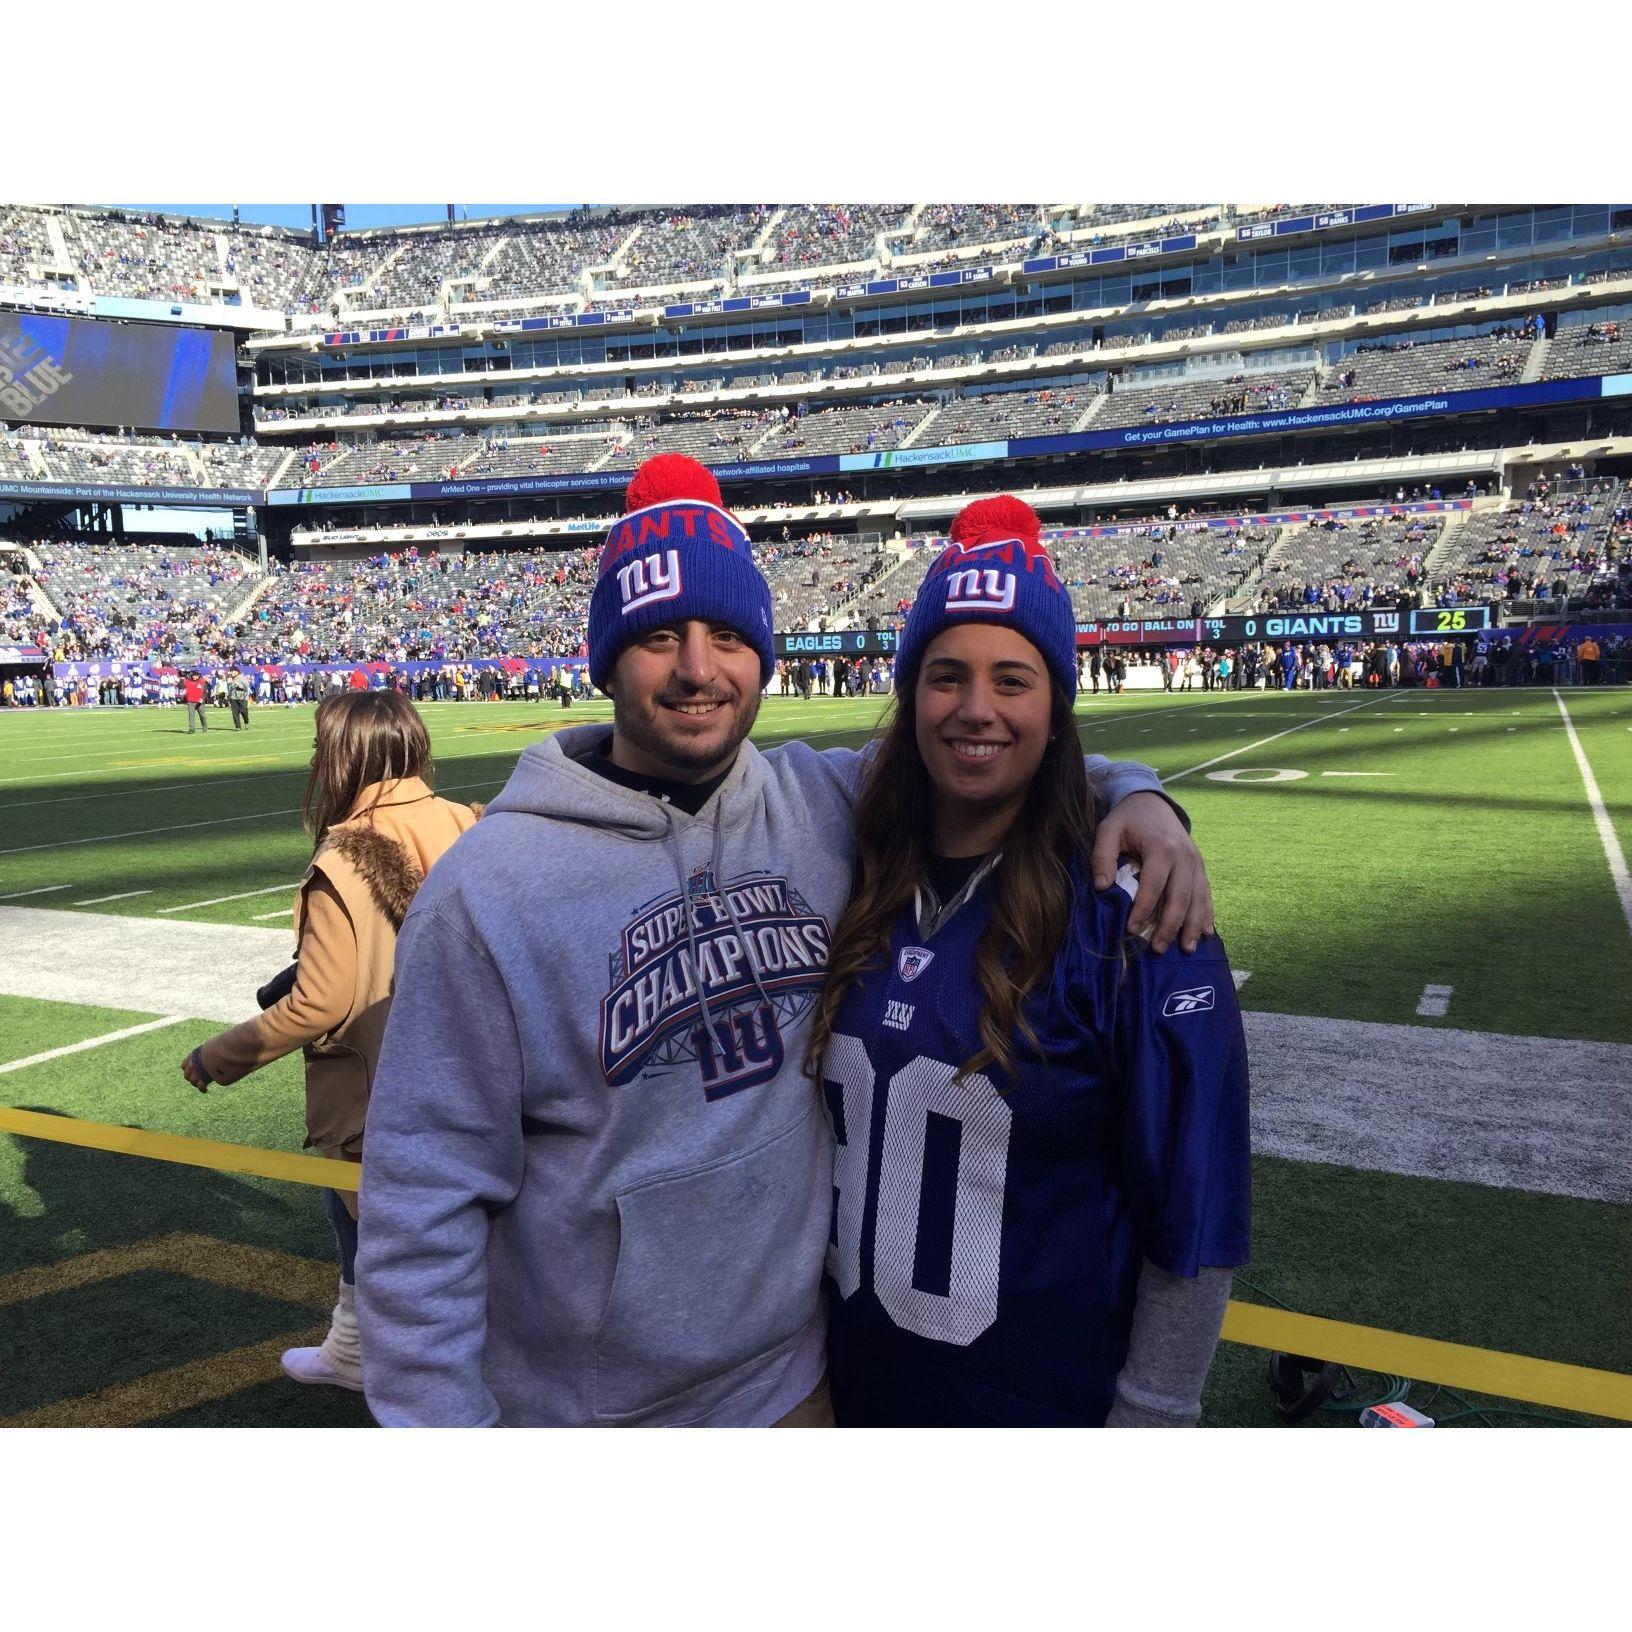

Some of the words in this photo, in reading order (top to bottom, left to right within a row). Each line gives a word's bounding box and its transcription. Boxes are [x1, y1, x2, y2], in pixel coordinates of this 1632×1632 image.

[1252, 229, 1271, 238] TAYLOR
[908, 281, 927, 289] CARSON
[0, 355, 74, 417] BLUE
[1125, 432, 1141, 442] Get
[1142, 431, 1162, 442] your
[1164, 425, 1210, 438] GamePlan
[1213, 424, 1225, 433] for
[1227, 420, 1260, 431] Health:
[1262, 400, 1448, 428] www.HackensackUMC.org/GamePlan
[895, 447, 976, 464] HackensackUMC
[713, 465, 775, 477] Network-affiliated
[777, 462, 810, 474] hospitals
[21, 486, 74, 495] Mountainside:
[76, 488, 91, 496] Part
[116, 490, 160, 498] Hackensack
[162, 491, 197, 501] University
[199, 492, 221, 500] Health
[441, 484, 465, 494] AirMed
[466, 484, 480, 492] One
[487, 482, 518, 492] providing
[520, 480, 534, 489] vital
[535, 478, 569, 489] helicopter
[571, 478, 599, 487] services
[427, 530, 448, 538] pepsi
[568, 523, 600, 532] MetLife
[608, 509, 736, 560] ANTS
[1122, 622, 1138, 631] GO
[1144, 620, 1174, 631] BALL
[1176, 620, 1194, 630] ON
[1204, 620, 1226, 629] TOL
[1245, 620, 1257, 637] 0
[1266, 615, 1362, 636] GIANTS
[1437, 611, 1466, 631] 25
[876, 632, 894, 640] TOL
[1212, 629, 1220, 639] 3
[785, 635, 842, 651] EAGLES
[856, 635, 866, 649] 0
[882, 641, 889, 650] 3
[631, 901, 703, 964] SUPER
[709, 885, 788, 922] BOWL
[611, 924, 829, 1053] CHAMPIONS
